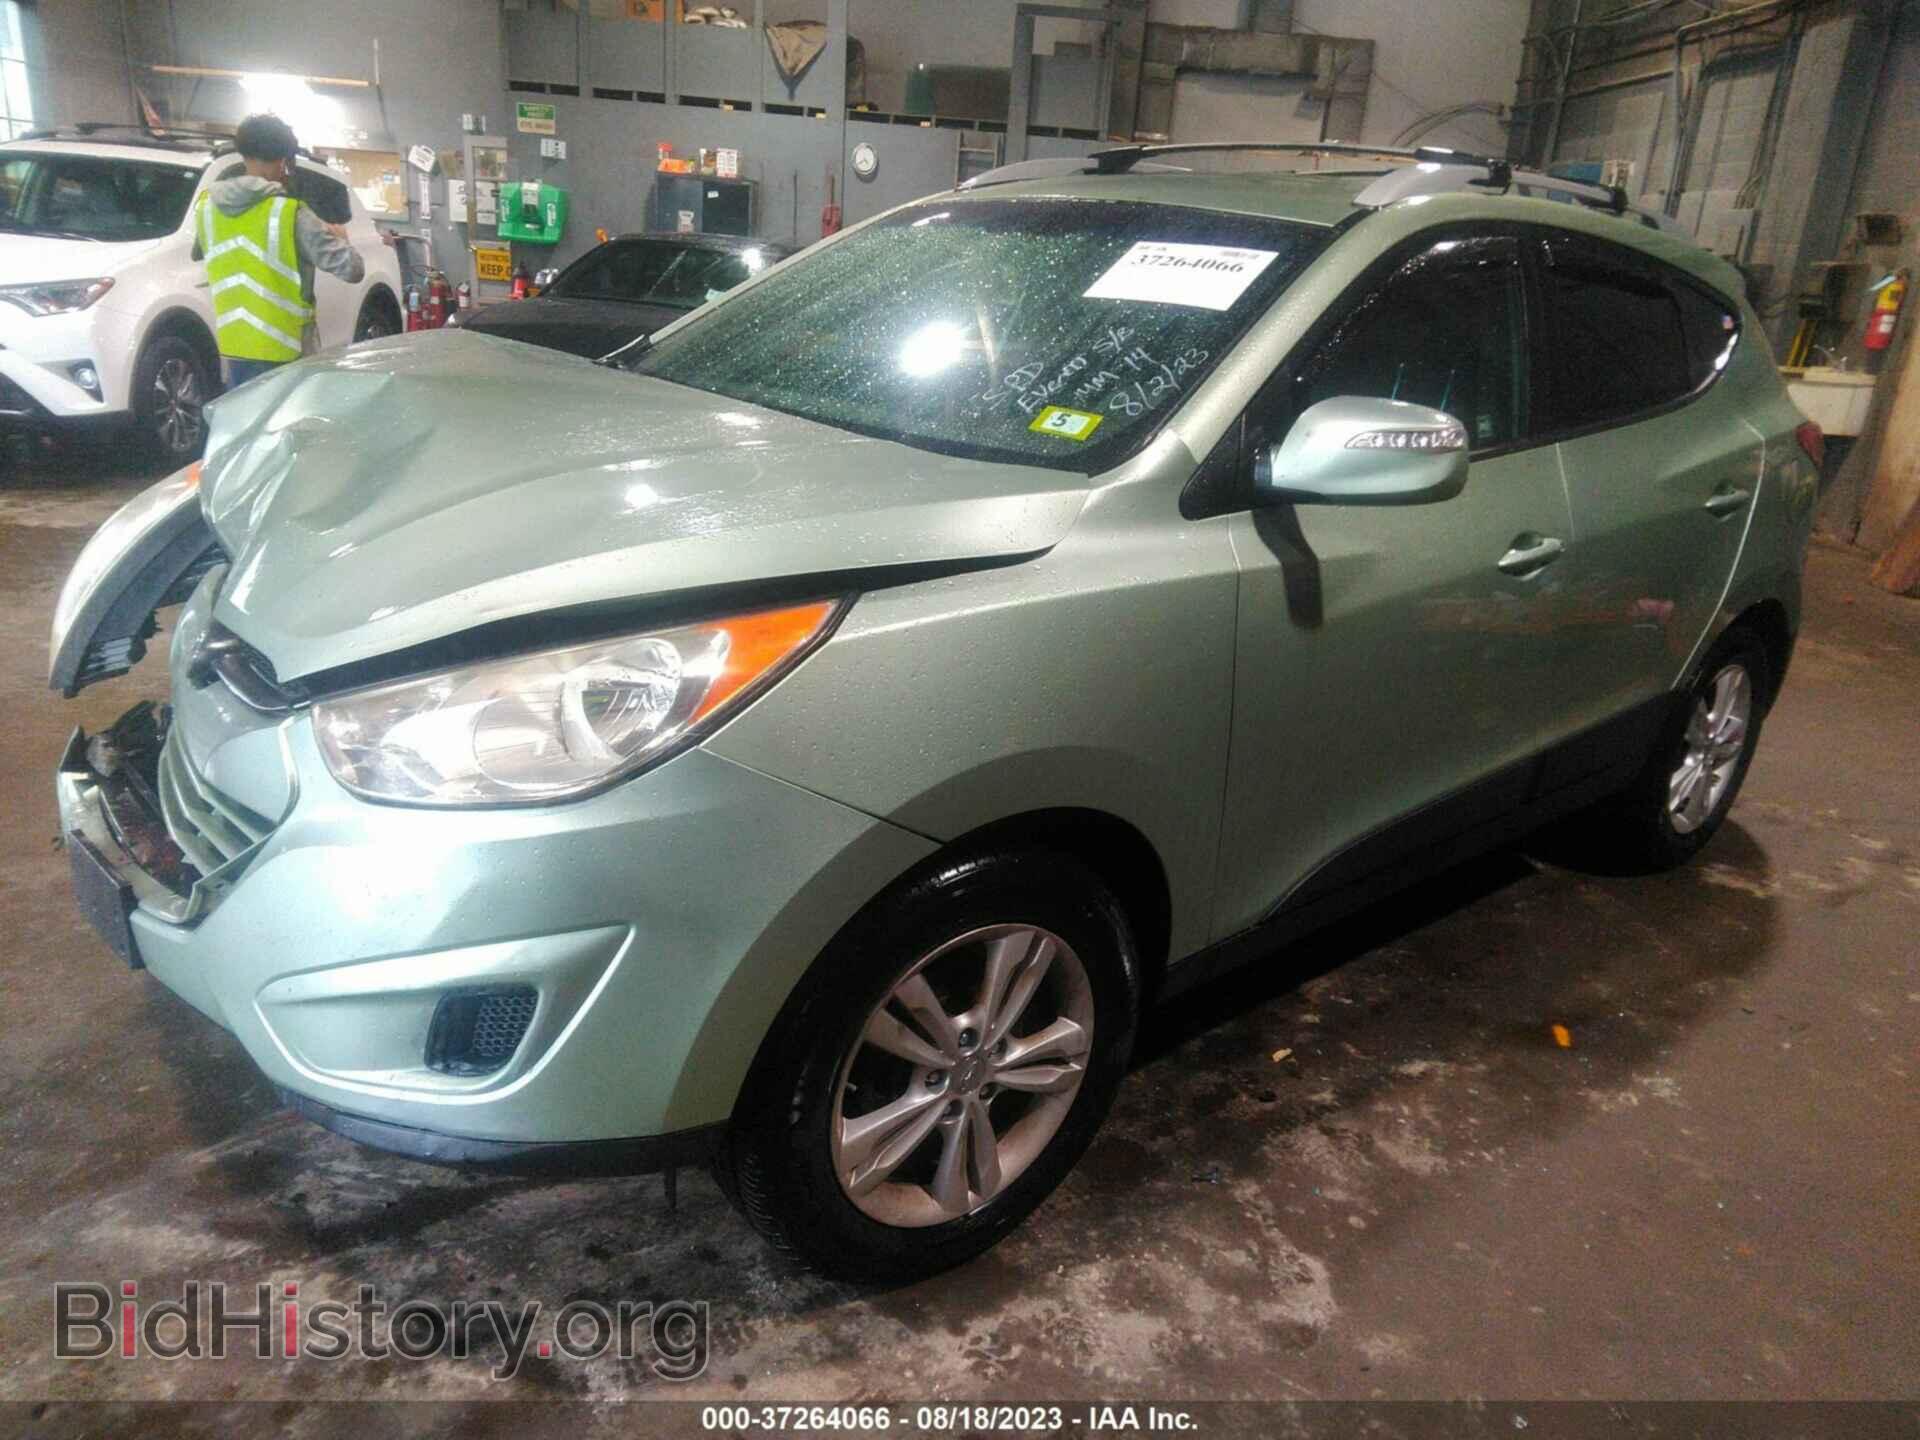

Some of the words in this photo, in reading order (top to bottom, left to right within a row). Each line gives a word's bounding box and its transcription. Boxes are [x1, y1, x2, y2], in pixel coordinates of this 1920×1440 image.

[480, 263, 504, 276] KEEP
[1131, 253, 1244, 273] 37264066
[1052, 413, 1072, 427] 5
